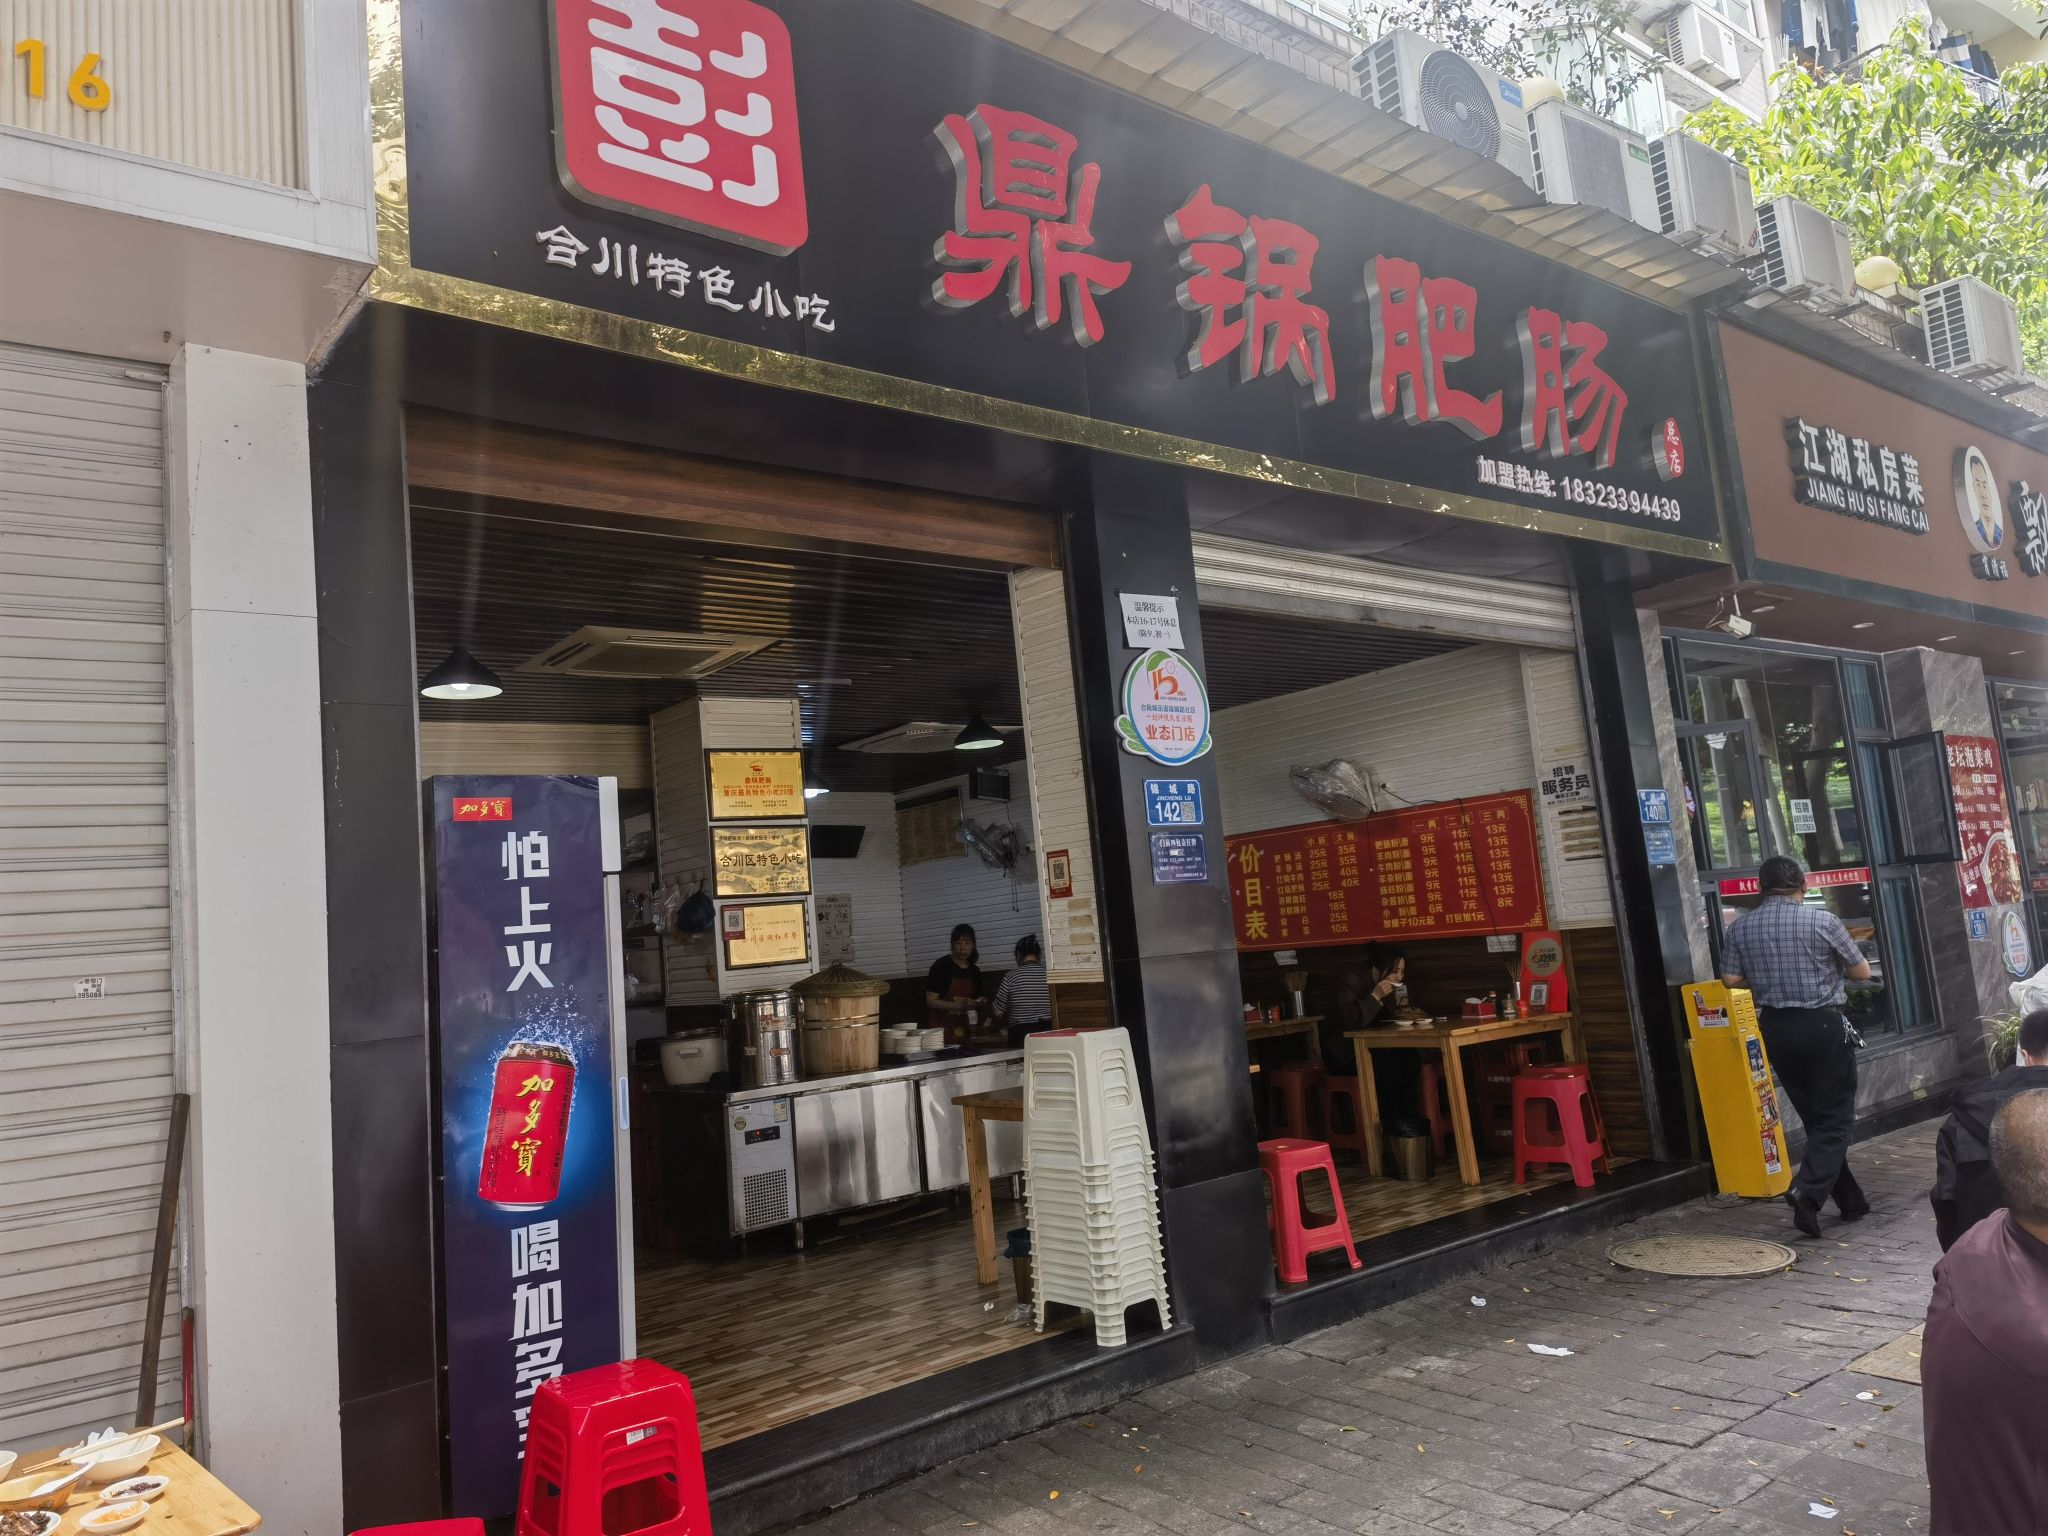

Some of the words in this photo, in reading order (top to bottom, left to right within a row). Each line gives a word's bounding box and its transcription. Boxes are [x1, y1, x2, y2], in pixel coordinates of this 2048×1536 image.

[536, 225, 836, 333] 合川特色小吃
[934, 104, 1629, 469] 鼎锅肥肠
[1666, 420, 1684, 474] 总店
[1799, 418, 1925, 505] 江湖私房菜
[1477, 454, 1557, 498] 加盟热线:
[1560, 476, 1681, 522] 18323394439
[1808, 477, 1846, 508] JIANG
[1847, 490, 1865, 513] HU
[1867, 496, 1880, 517] SI
[1880, 499, 1911, 526] FANG
[1911, 509, 1930, 532] CAI
[1134, 601, 1165, 613] 温馨提示
[1127, 614, 1178, 628] 本店16-17号休息
[1145, 724, 1196, 742] 业态门店
[1552, 764, 1575, 778] 招聘
[1150, 783, 1196, 795] 锦城路
[1541, 774, 1591, 796] 服务员
[1155, 801, 1181, 822] 142
[1645, 805, 1658, 821] 140
[1420, 833, 1435, 844] 9元
[1452, 828, 1471, 839] 11元
[1486, 824, 1507, 835] 13元
[1309, 848, 1327, 859] 25元
[1338, 844, 1356, 855] 35元
[1422, 845, 1436, 856] 9元
[1453, 840, 1472, 850] 11元
[1487, 836, 1509, 846] 13元
[720, 853, 804, 868] 合川区特色小吃
[1310, 860, 1328, 870] 25元
[1339, 855, 1357, 866] 35元
[1423, 857, 1438, 867] 9元
[1454, 852, 1473, 862] 11元
[1488, 848, 1510, 859] 13元
[1311, 870, 1329, 880] 25元
[1340, 866, 1358, 877] 40元
[1425, 868, 1439, 879] 9元
[1456, 864, 1475, 875] 11元
[1490, 860, 1512, 871] 13元
[1312, 881, 1330, 891] 25元
[1341, 877, 1359, 888] 40元
[1426, 880, 1441, 890] 9元
[1457, 876, 1477, 886] 11元
[1492, 872, 1513, 883] 13元
[1240, 844, 1268, 940] 价目表
[1328, 890, 1345, 900] 18元
[1427, 891, 1442, 902] 9元
[1459, 887, 1478, 898] 11元
[1493, 884, 1515, 895] 13元
[502, 830, 556, 993] 怕上火
[1428, 903, 1443, 914] 6元
[1462, 900, 1477, 910] 7元
[1498, 897, 1513, 908] 8元
[1330, 913, 1348, 922] 25元
[1331, 923, 1349, 933] 10元
